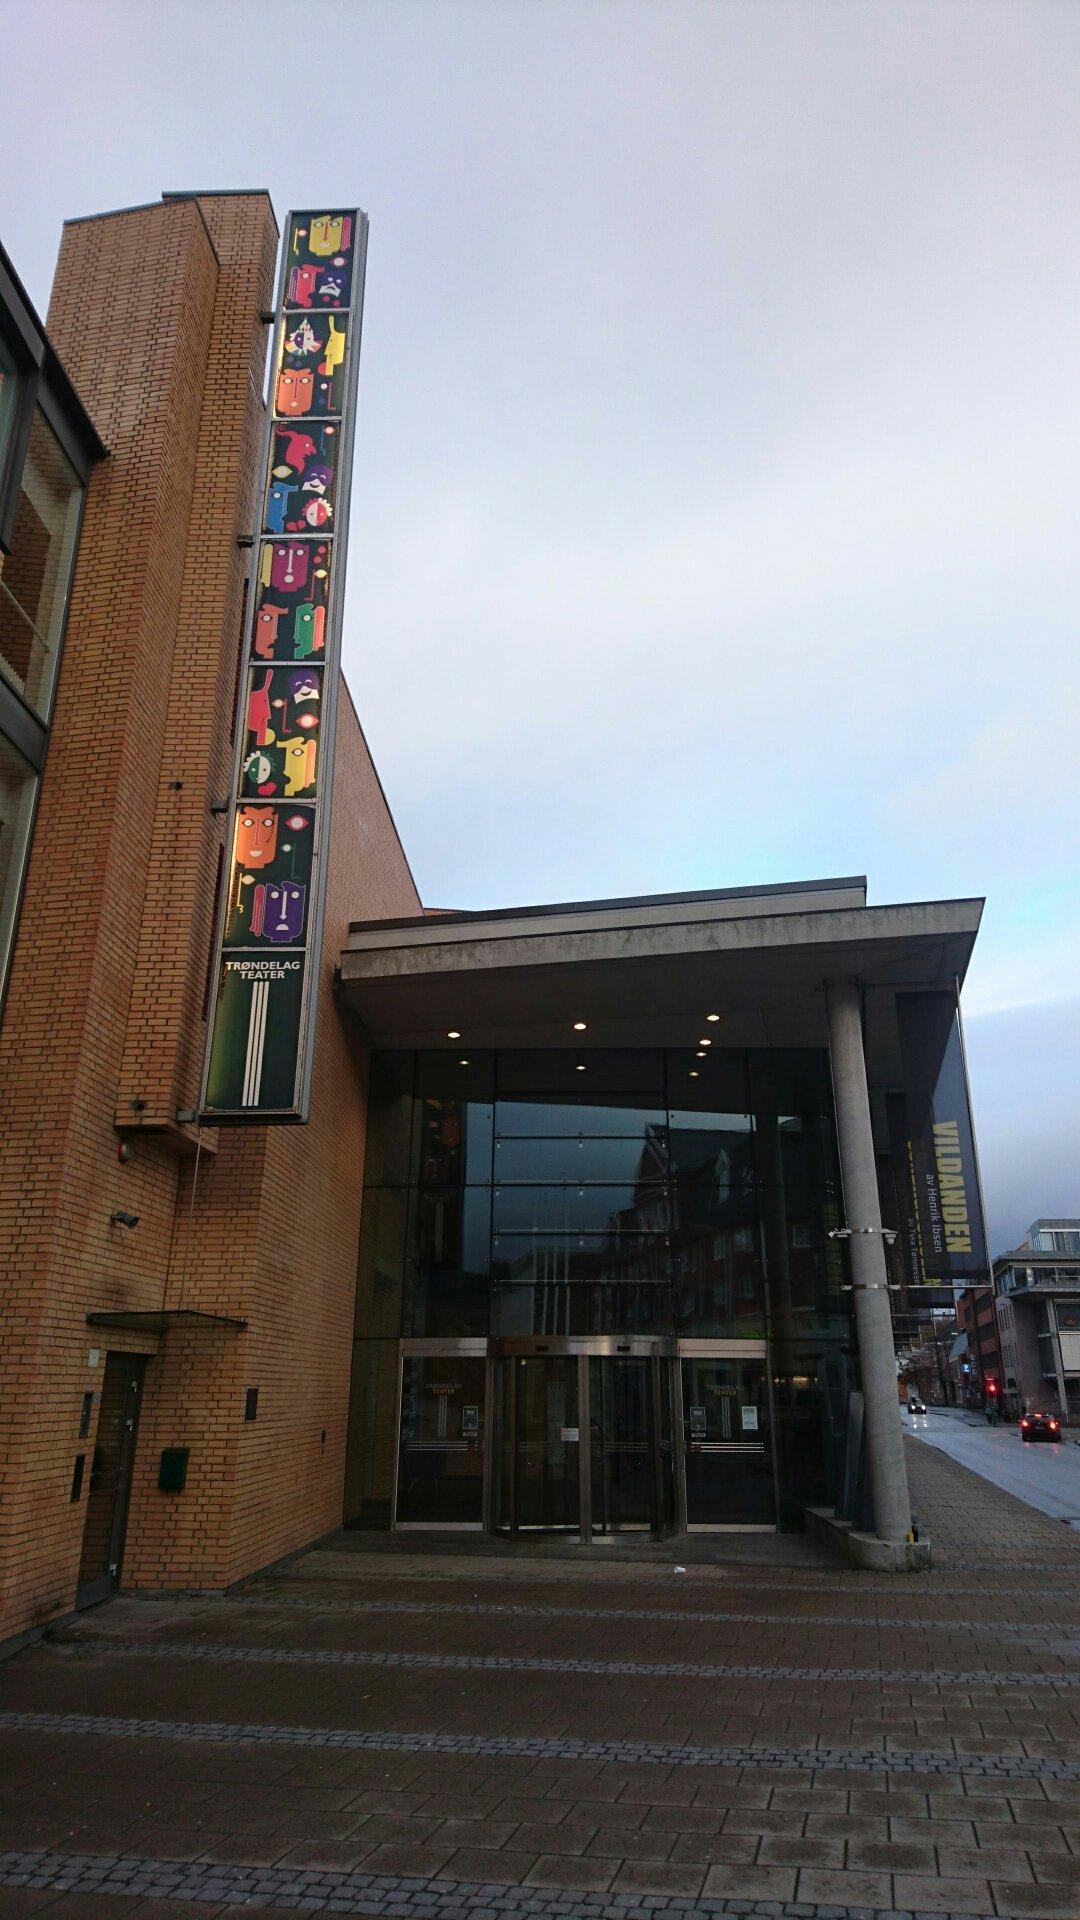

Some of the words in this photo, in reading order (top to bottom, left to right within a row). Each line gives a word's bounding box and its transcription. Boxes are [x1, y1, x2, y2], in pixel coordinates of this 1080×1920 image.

[225, 961, 300, 971] TRØNDELAG
[239, 970, 285, 979] TEATER
[926, 1174, 934, 1187] av
[932, 1120, 972, 1253] VILDANDEN
[928, 1189, 940, 1222] Henrik
[932, 1224, 943, 1253] Ibsen
